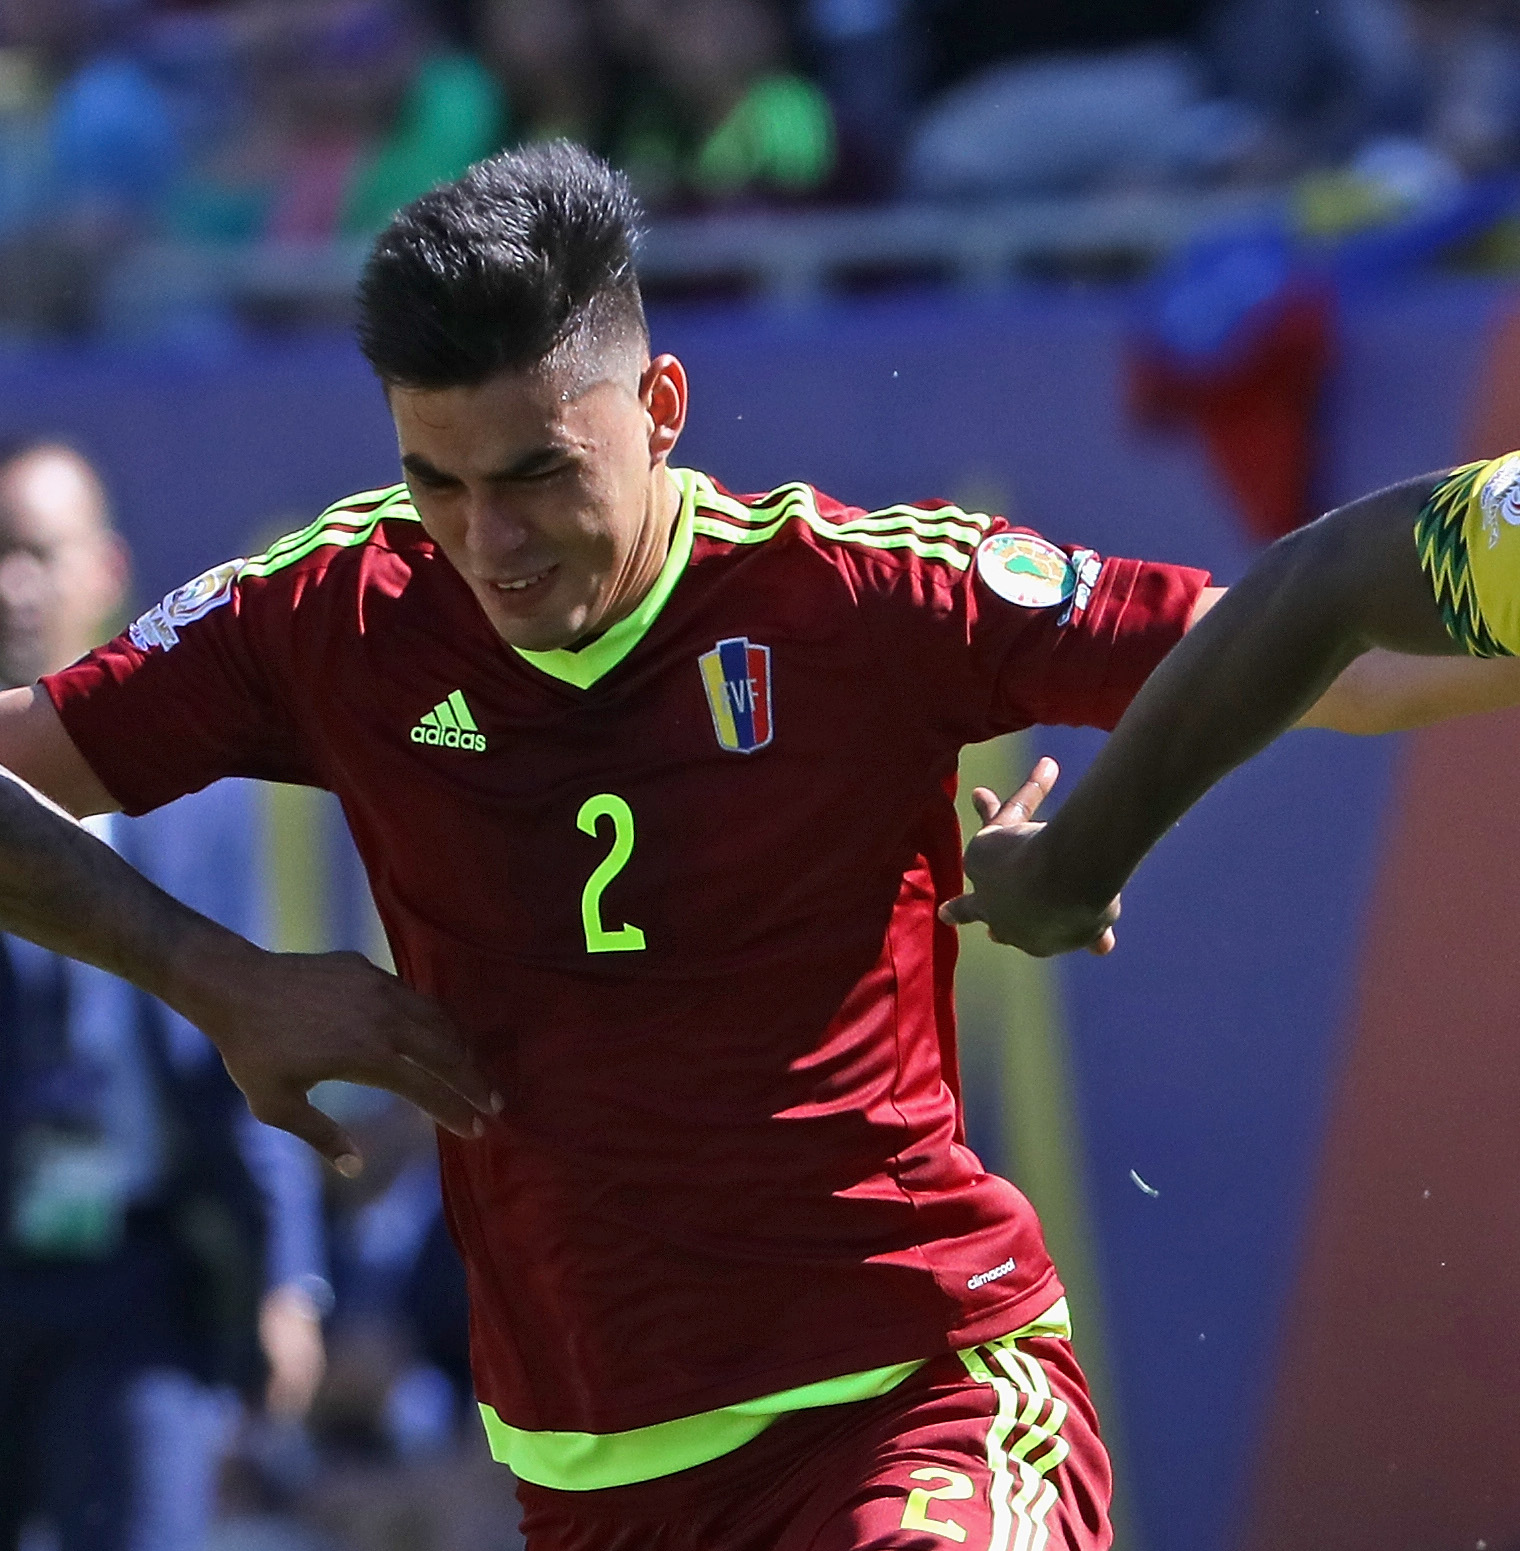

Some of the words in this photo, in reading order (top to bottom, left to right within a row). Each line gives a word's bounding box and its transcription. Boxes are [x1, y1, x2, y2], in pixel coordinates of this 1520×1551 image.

[410, 725, 487, 753] adidas
[576, 792, 647, 954] 2
[967, 1256, 1016, 1290] climacool
[900, 1467, 976, 1543] 2
